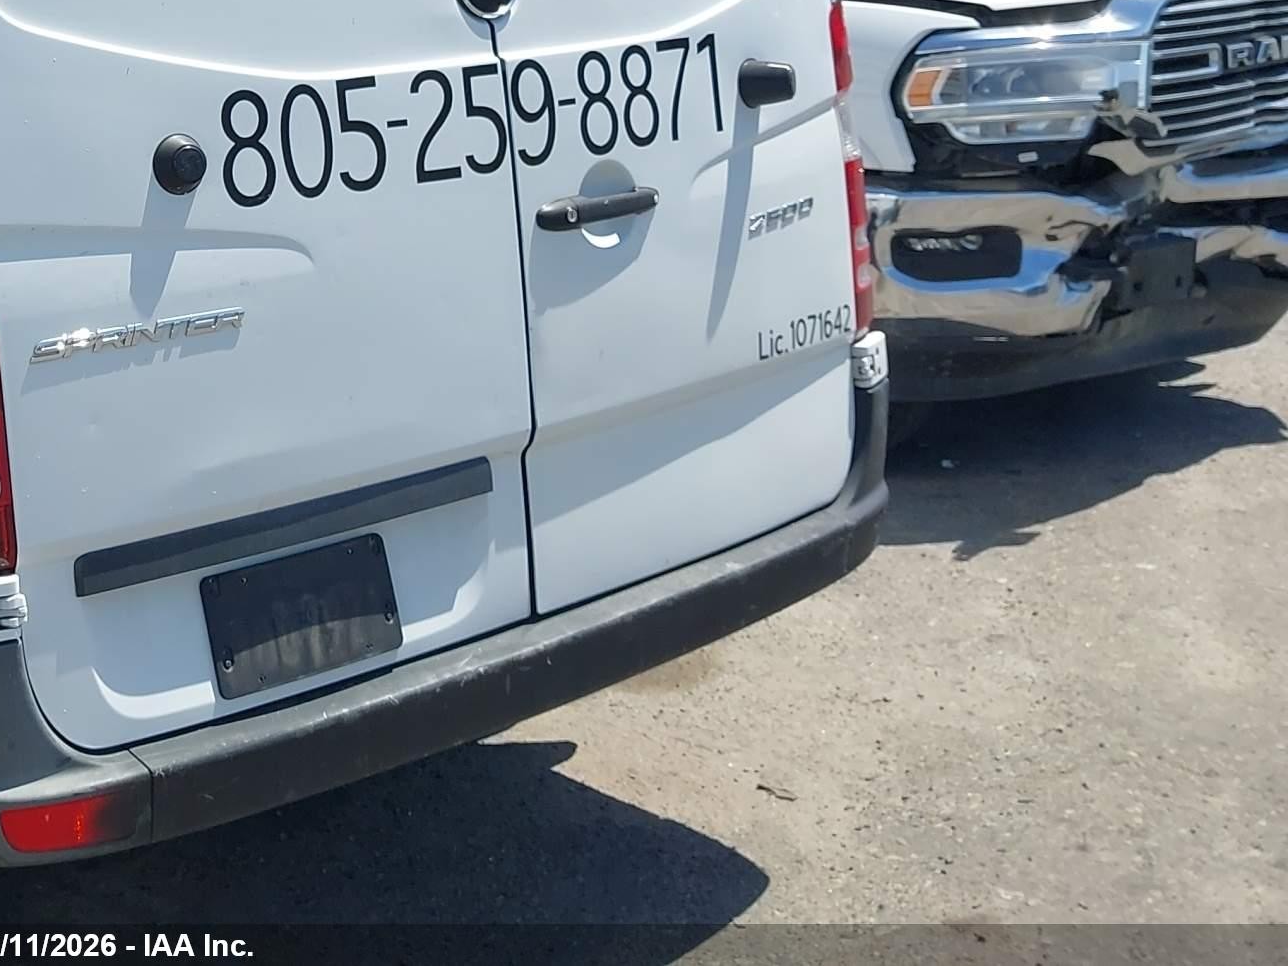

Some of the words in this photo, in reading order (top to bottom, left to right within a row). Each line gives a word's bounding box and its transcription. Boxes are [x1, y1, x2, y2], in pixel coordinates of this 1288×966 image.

[221, 33, 725, 207] 805-259-8871
[30, 306, 245, 364] SPRINTER
[758, 304, 851, 361] Lic.1071642
